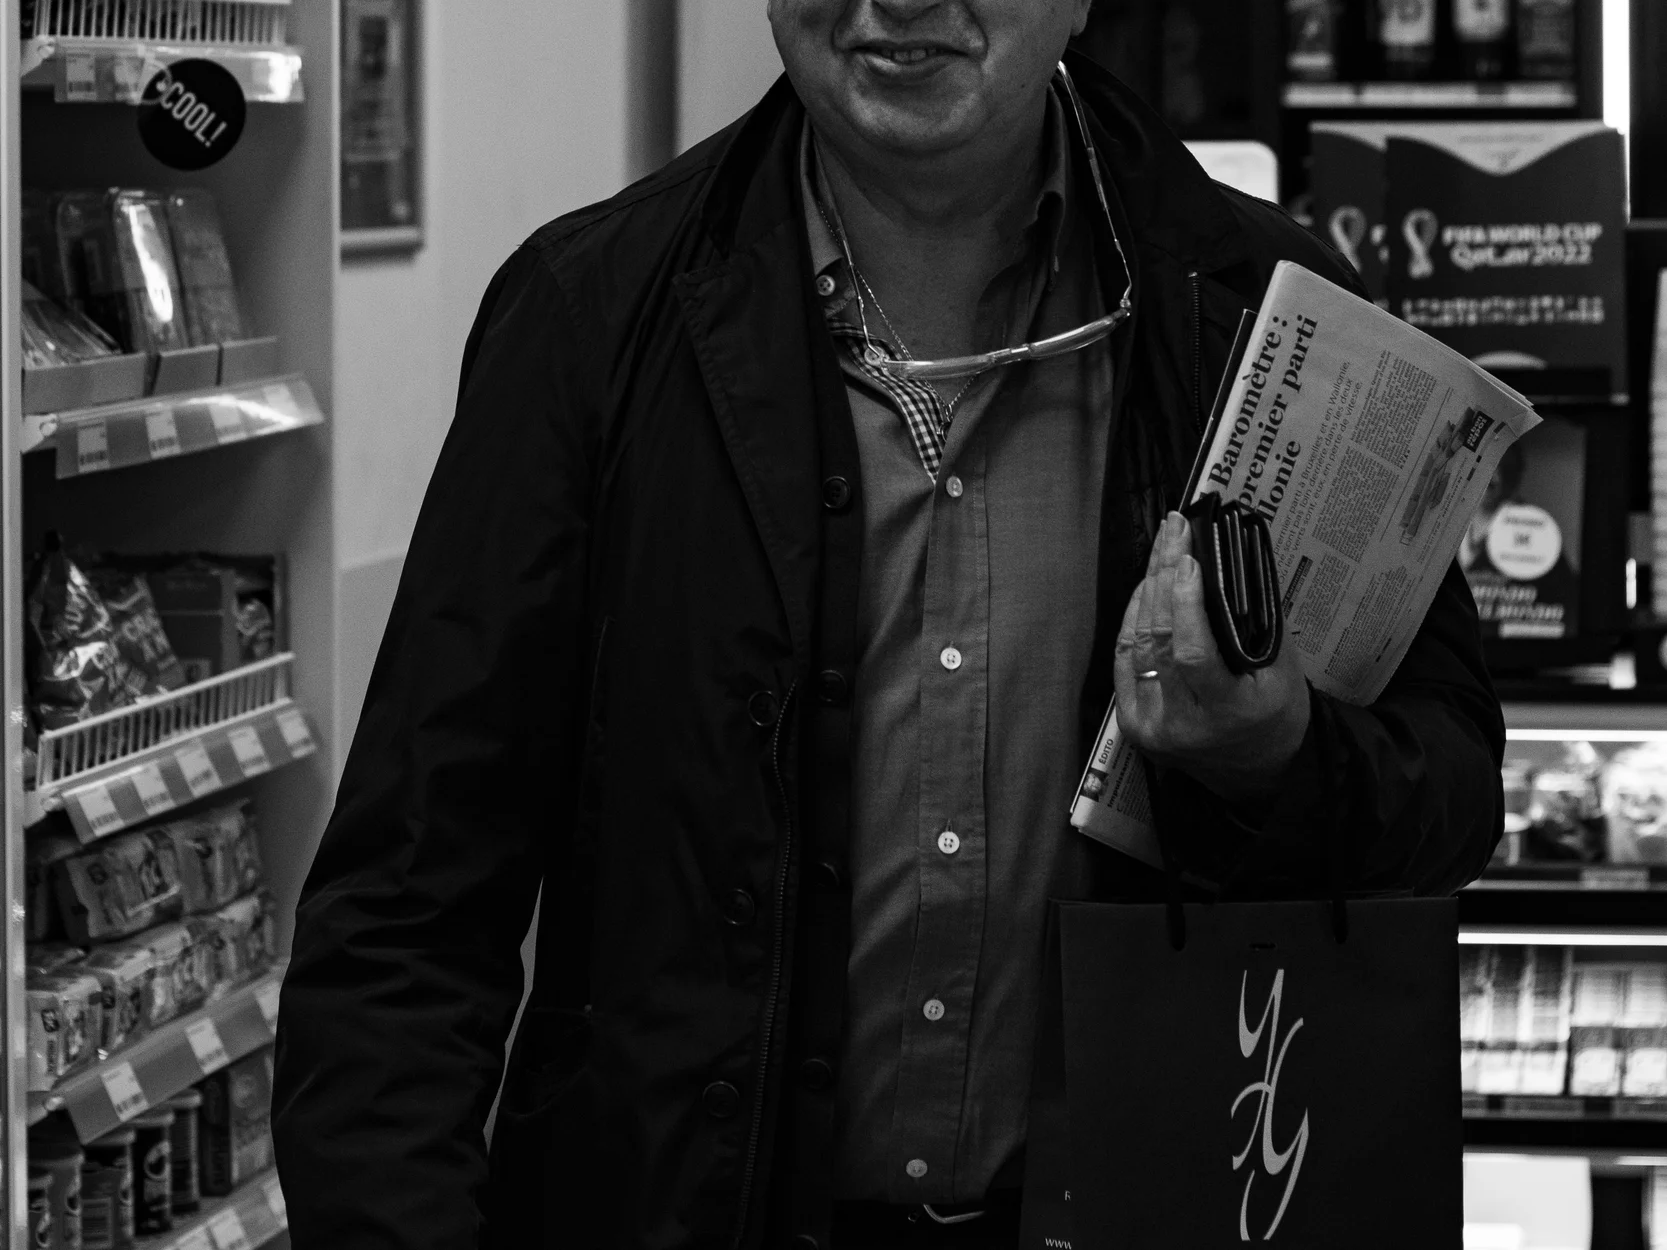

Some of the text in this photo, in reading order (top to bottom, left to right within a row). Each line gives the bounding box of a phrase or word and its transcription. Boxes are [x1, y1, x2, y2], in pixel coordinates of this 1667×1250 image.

[161, 81, 227, 147] COOL!
[1563, 222, 1602, 241] CUP
[1208, 331, 1283, 489] Baromètre
[1237, 315, 1318, 513] premier parti
[1289, 490, 1303, 515] parti
[1301, 436, 1323, 480] Bruxelles
[1320, 423, 1328, 434] et
[1325, 408, 1333, 422] en
[1256, 440, 1301, 526] llonie
[1284, 530, 1297, 552] sont
[1293, 511, 1304, 529] pas
[1300, 489, 1313, 508] loin
[1325, 423, 1338, 447] dans
[1334, 407, 1344, 421] les
[1340, 379, 1353, 405] deux
[1285, 555, 1295, 568] les
[1293, 528, 1306, 551] verts
[1323, 464, 1332, 477] en
[1329, 434, 1343, 462] perte
[1340, 419, 1350, 433] de
[1098, 739, 1114, 765] ÉDITO
